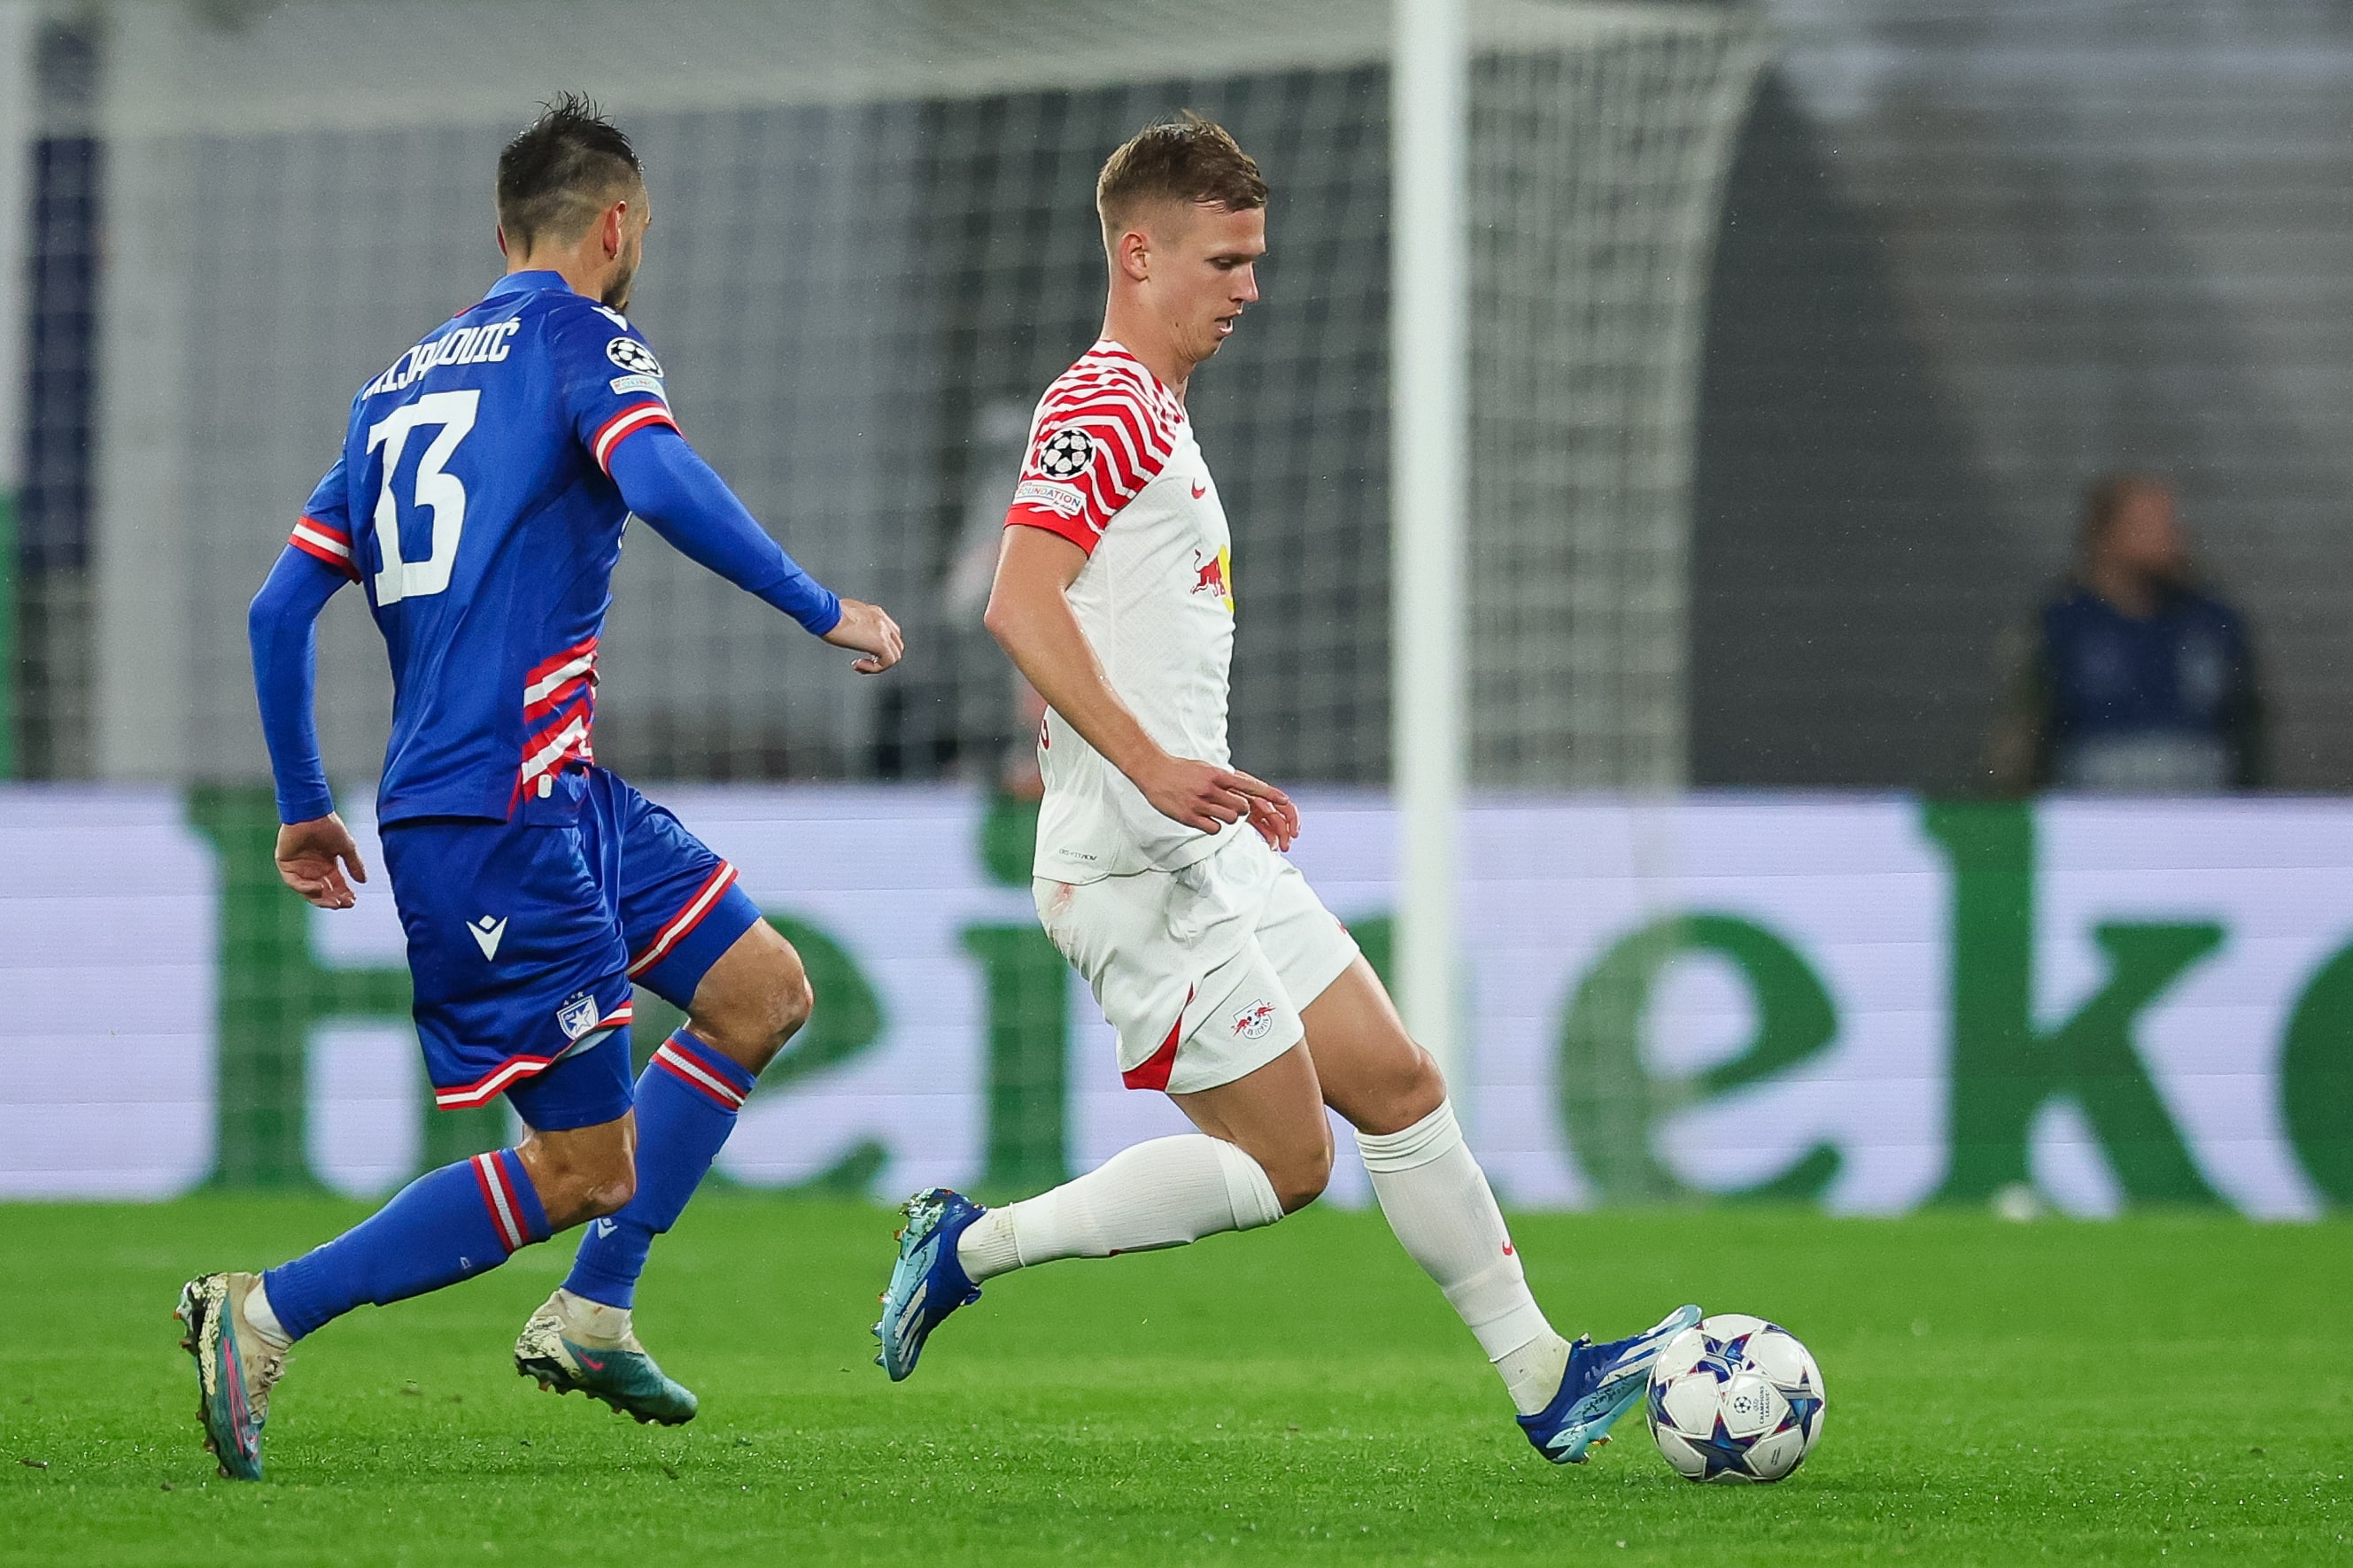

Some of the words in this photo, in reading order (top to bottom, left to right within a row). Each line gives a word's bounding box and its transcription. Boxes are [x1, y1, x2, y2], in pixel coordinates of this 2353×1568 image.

[366, 389, 481, 607] 13
[1017, 487, 1081, 506] FOUNDATION
[185, 788, 2353, 1209] Heiek
